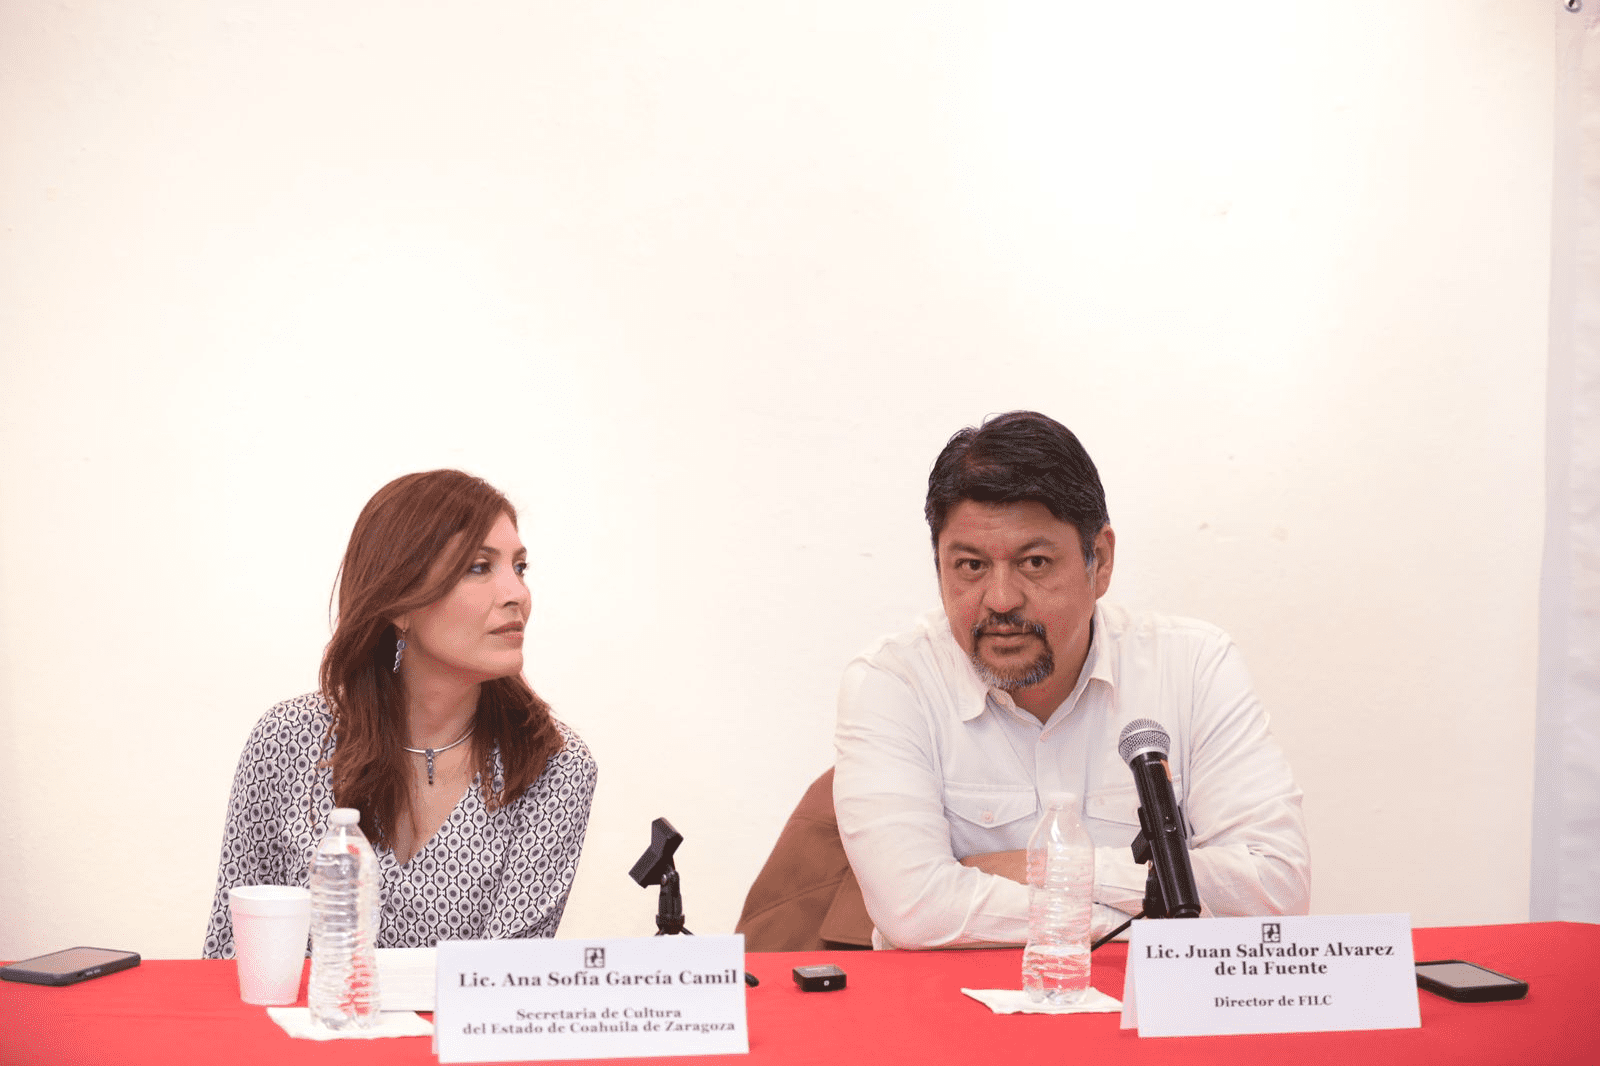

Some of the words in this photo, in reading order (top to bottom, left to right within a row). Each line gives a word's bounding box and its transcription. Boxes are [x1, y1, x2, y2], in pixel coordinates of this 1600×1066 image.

[1145, 943, 1180, 959] Lic.
[1184, 944, 1232, 959] Juan
[1235, 942, 1320, 959] Salvador
[1323, 941, 1395, 957] Alvarez
[1214, 960, 1237, 976] de
[1241, 960, 1259, 976] la
[1263, 960, 1328, 976] Fuente
[459, 972, 496, 988] Lic.
[503, 972, 542, 987] Ana
[547, 970, 600, 986] Sofía
[605, 970, 673, 986] García
[678, 968, 737, 985] Camil
[1214, 995, 1275, 1008] Director
[1277, 994, 1295, 1007] de
[1298, 994, 1332, 1007] FILC
[516, 1007, 597, 1020] Secretaria
[600, 1007, 619, 1019] de
[623, 1006, 682, 1019] Cultura
[462, 1022, 487, 1035] del
[491, 1022, 544, 1035] Estado
[547, 1021, 566, 1034] de
[569, 1020, 639, 1033] Coahuila
[642, 1020, 661, 1032] de
[665, 1020, 735, 1034] Zaragoza
